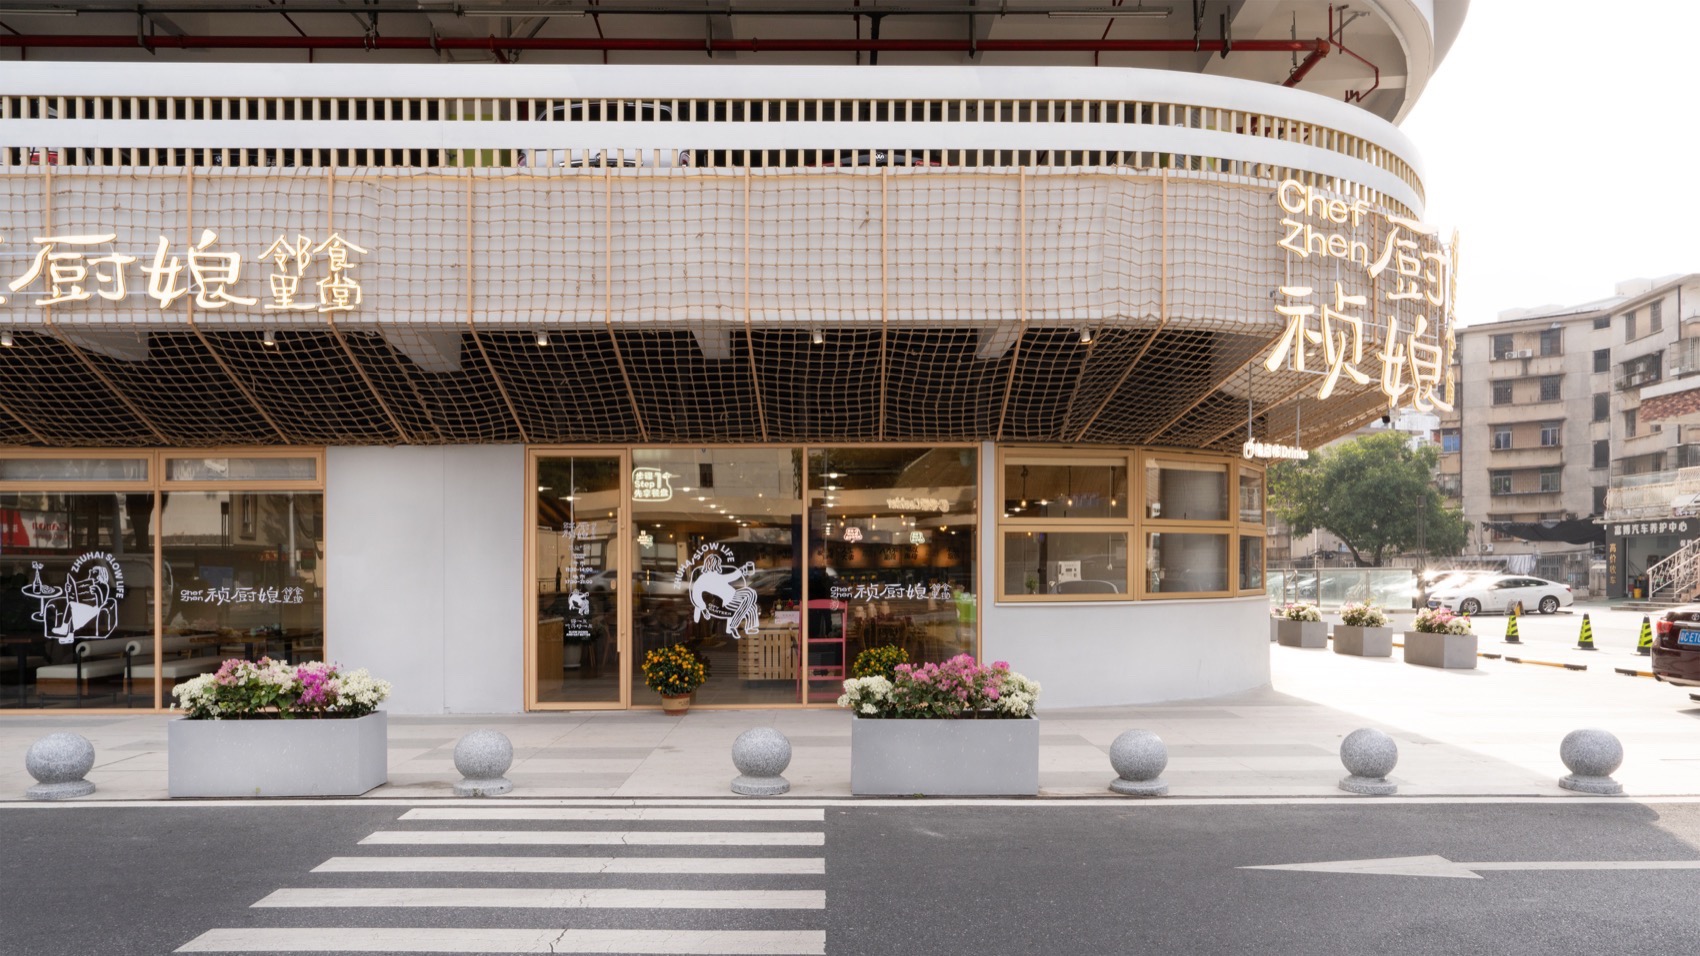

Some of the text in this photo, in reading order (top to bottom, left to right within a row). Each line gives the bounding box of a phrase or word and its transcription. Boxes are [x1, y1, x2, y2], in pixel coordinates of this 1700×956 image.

[1278, 179, 1370, 228] Chef
[1277, 218, 1368, 267] Zhen
[0, 229, 259, 310] 厨娘
[634, 480, 655, 490] Step
[71, 551, 125, 599] ZHUHAI SLOW LIFE
[693, 542, 719, 560] SLOW
[720, 544, 735, 563] LIFE
